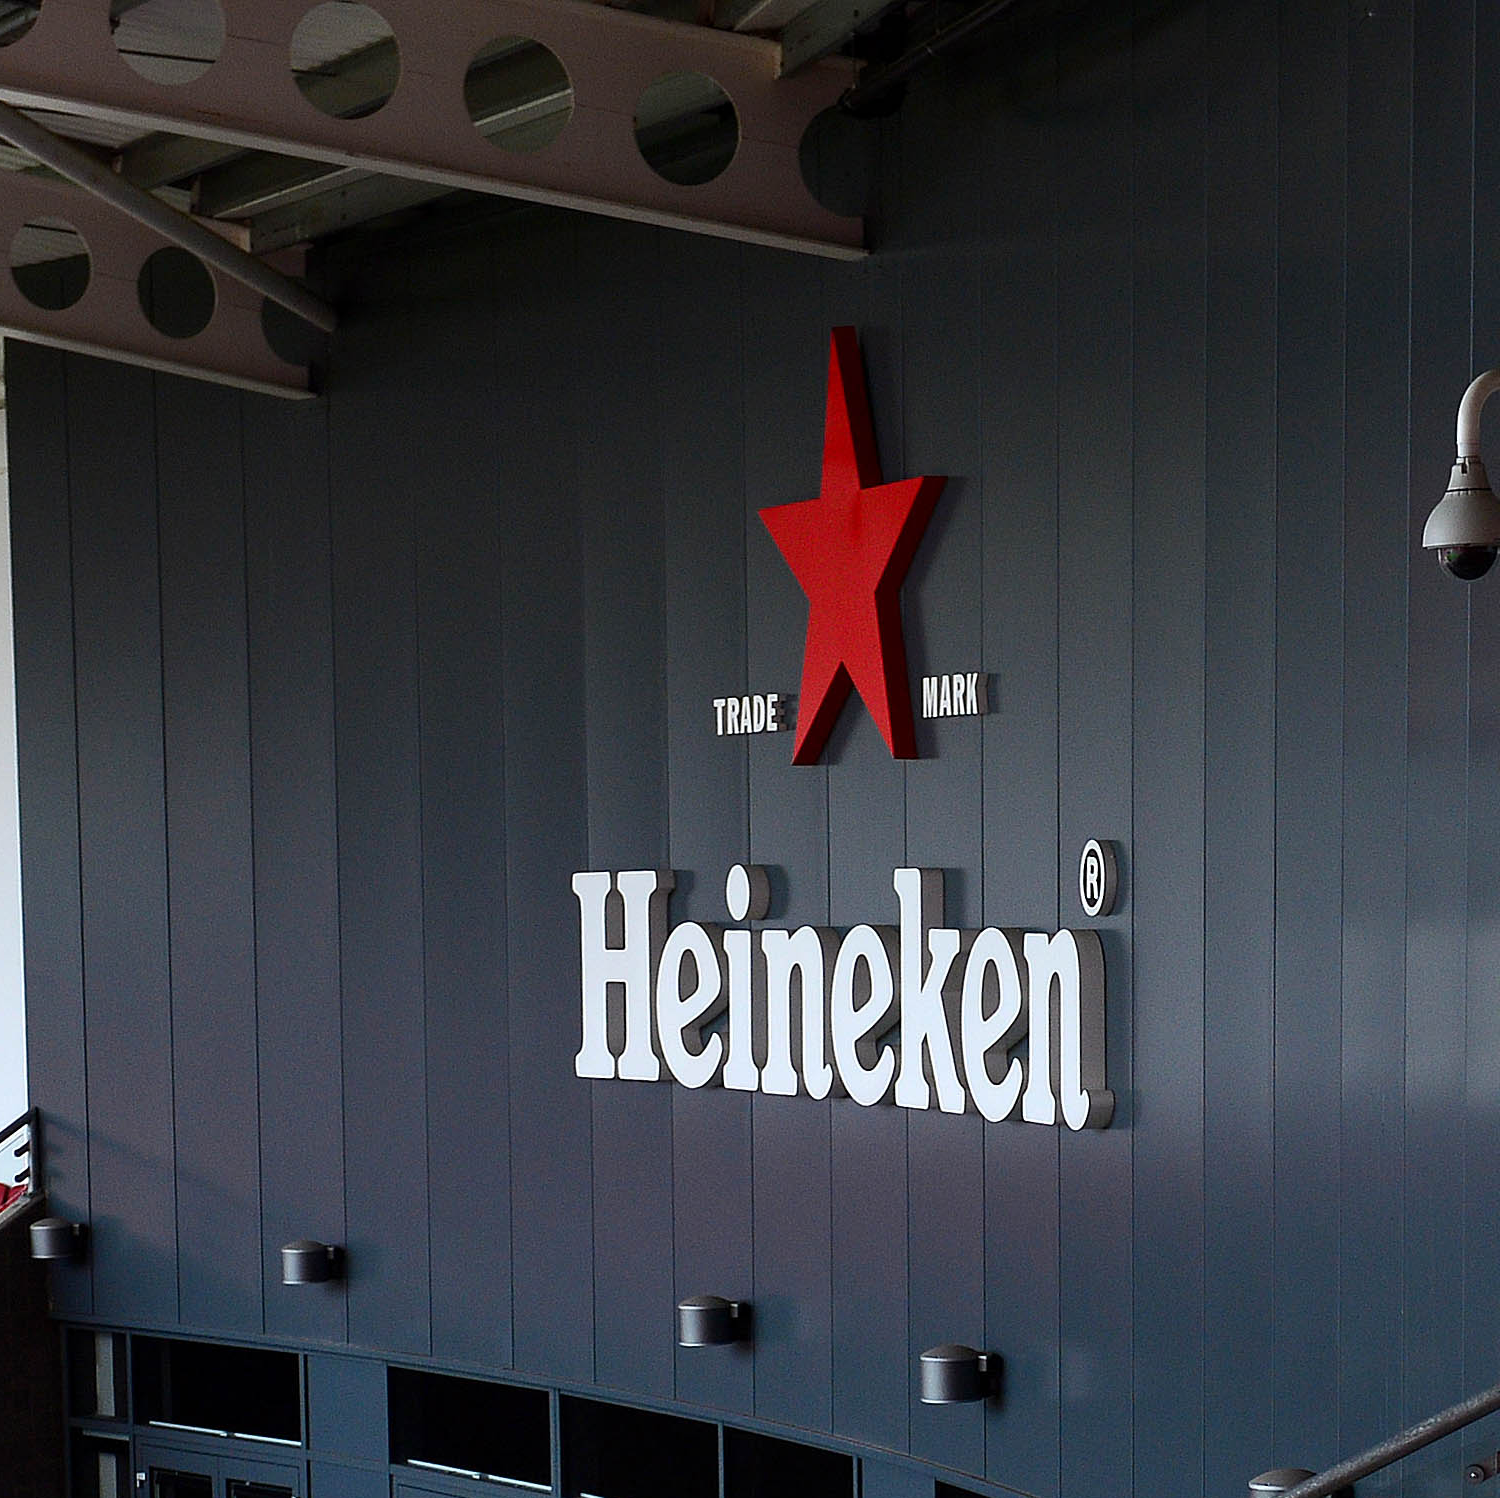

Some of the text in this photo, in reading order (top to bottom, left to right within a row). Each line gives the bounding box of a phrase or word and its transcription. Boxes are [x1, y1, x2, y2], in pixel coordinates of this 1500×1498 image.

[712, 672, 979, 736] TRADE MARK
[571, 864, 1091, 1131] Heineken
